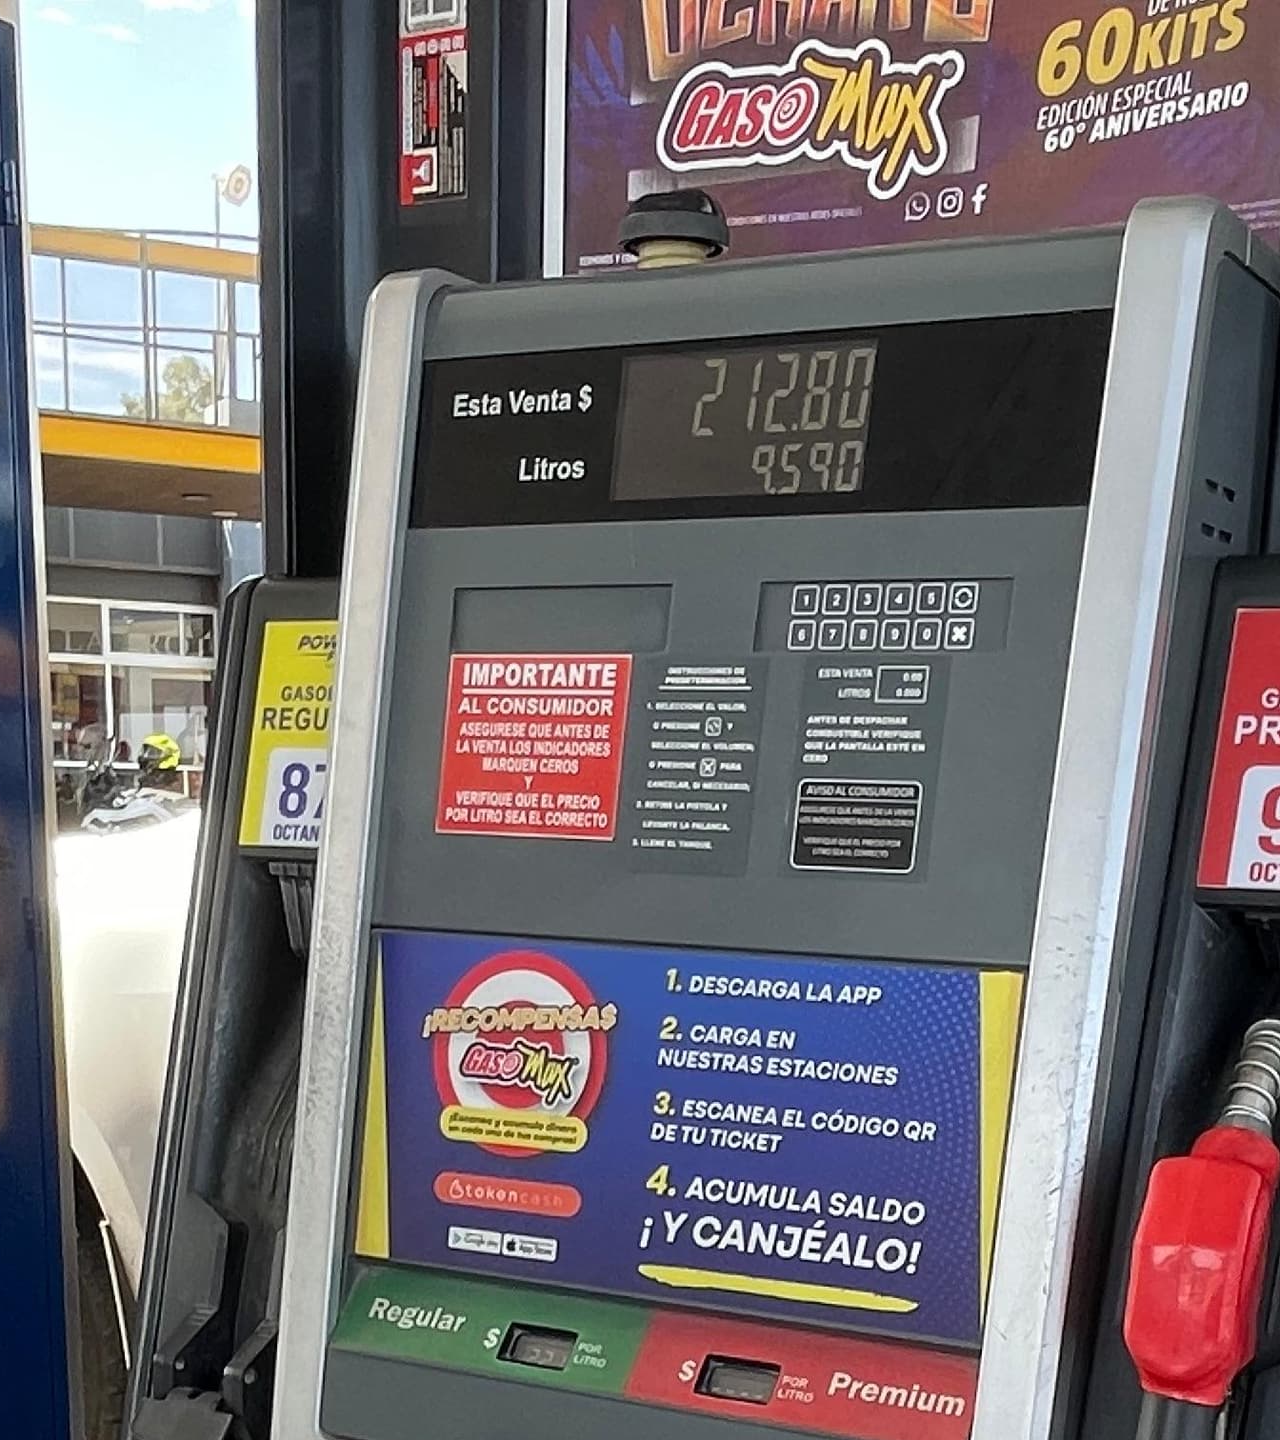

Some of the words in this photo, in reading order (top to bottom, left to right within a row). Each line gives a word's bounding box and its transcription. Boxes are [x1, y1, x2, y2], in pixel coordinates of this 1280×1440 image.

[1036, 91, 1107, 131] EDICIÓN
[1111, 71, 1193, 113] ESPECIAL
[1088, 82, 1250, 144] ANIVERSARIO
[452, 391, 502, 417] Esta
[509, 389, 571, 414] Venta
[578, 384, 593, 412] $
[518, 457, 585, 481] Litros
[298, 635, 337, 650] POW
[463, 662, 617, 687] IMPORTANTE
[281, 685, 333, 702] GASO
[261, 707, 328, 731] REGU
[458, 697, 481, 714] AL
[487, 698, 613, 716] CONSUMIDOR
[459, 722, 527, 737] ASEGURESE
[528, 723, 550, 738] QUE
[551, 724, 591, 739] ANTES
[593, 724, 610, 739] DE
[456, 740, 470, 753] LA
[472, 740, 506, 754] VENTA
[509, 741, 531, 755] LOS
[533, 741, 611, 758] INDICADORES
[482, 757, 537, 773] MARQUEN
[540, 758, 579, 774] CEROS
[523, 775, 534, 790] Y
[456, 791, 513, 806] VERIFIQUE
[515, 793, 539, 808] QUE
[541, 793, 554, 808] EL
[557, 794, 600, 810] PRECIO
[445, 807, 468, 822] POR
[470, 808, 502, 824] LITRO
[504, 809, 527, 825] SEA
[528, 810, 543, 826] EL
[545, 811, 608, 828] CORRECTO
[273, 824, 320, 841] OCTAN
[666, 968, 682, 992] 1.
[688, 975, 801, 999] DESCARGA
[806, 983, 832, 1002] LA
[836, 986, 882, 1006] APP
[659, 1016, 682, 1041] 2.
[689, 1025, 762, 1047] CARGA
[766, 1030, 796, 1050] EN
[657, 1049, 763, 1074] NUESTRAS
[766, 1056, 899, 1087] ESTACIONES
[653, 1091, 675, 1116] 3.
[682, 1099, 777, 1126] ESCANEA
[781, 1109, 806, 1128] EL
[811, 1109, 899, 1137] CÓDIGO
[903, 1120, 937, 1141] QR
[650, 1123, 677, 1142] DE
[681, 1126, 707, 1145] TU
[709, 1128, 782, 1153] TICKET
[645, 1165, 676, 1196] 4.
[685, 1176, 822, 1213] ACUMULA
[827, 1192, 925, 1226] SALDO
[692, 1215, 922, 1274] CANJÉALO!
[367, 1297, 467, 1333] Regular
[483, 1327, 501, 1350] $
[577, 1342, 602, 1355] POR
[678, 1360, 697, 1382] $
[781, 1375, 809, 1389] POR
[827, 1371, 966, 1417] Premium
